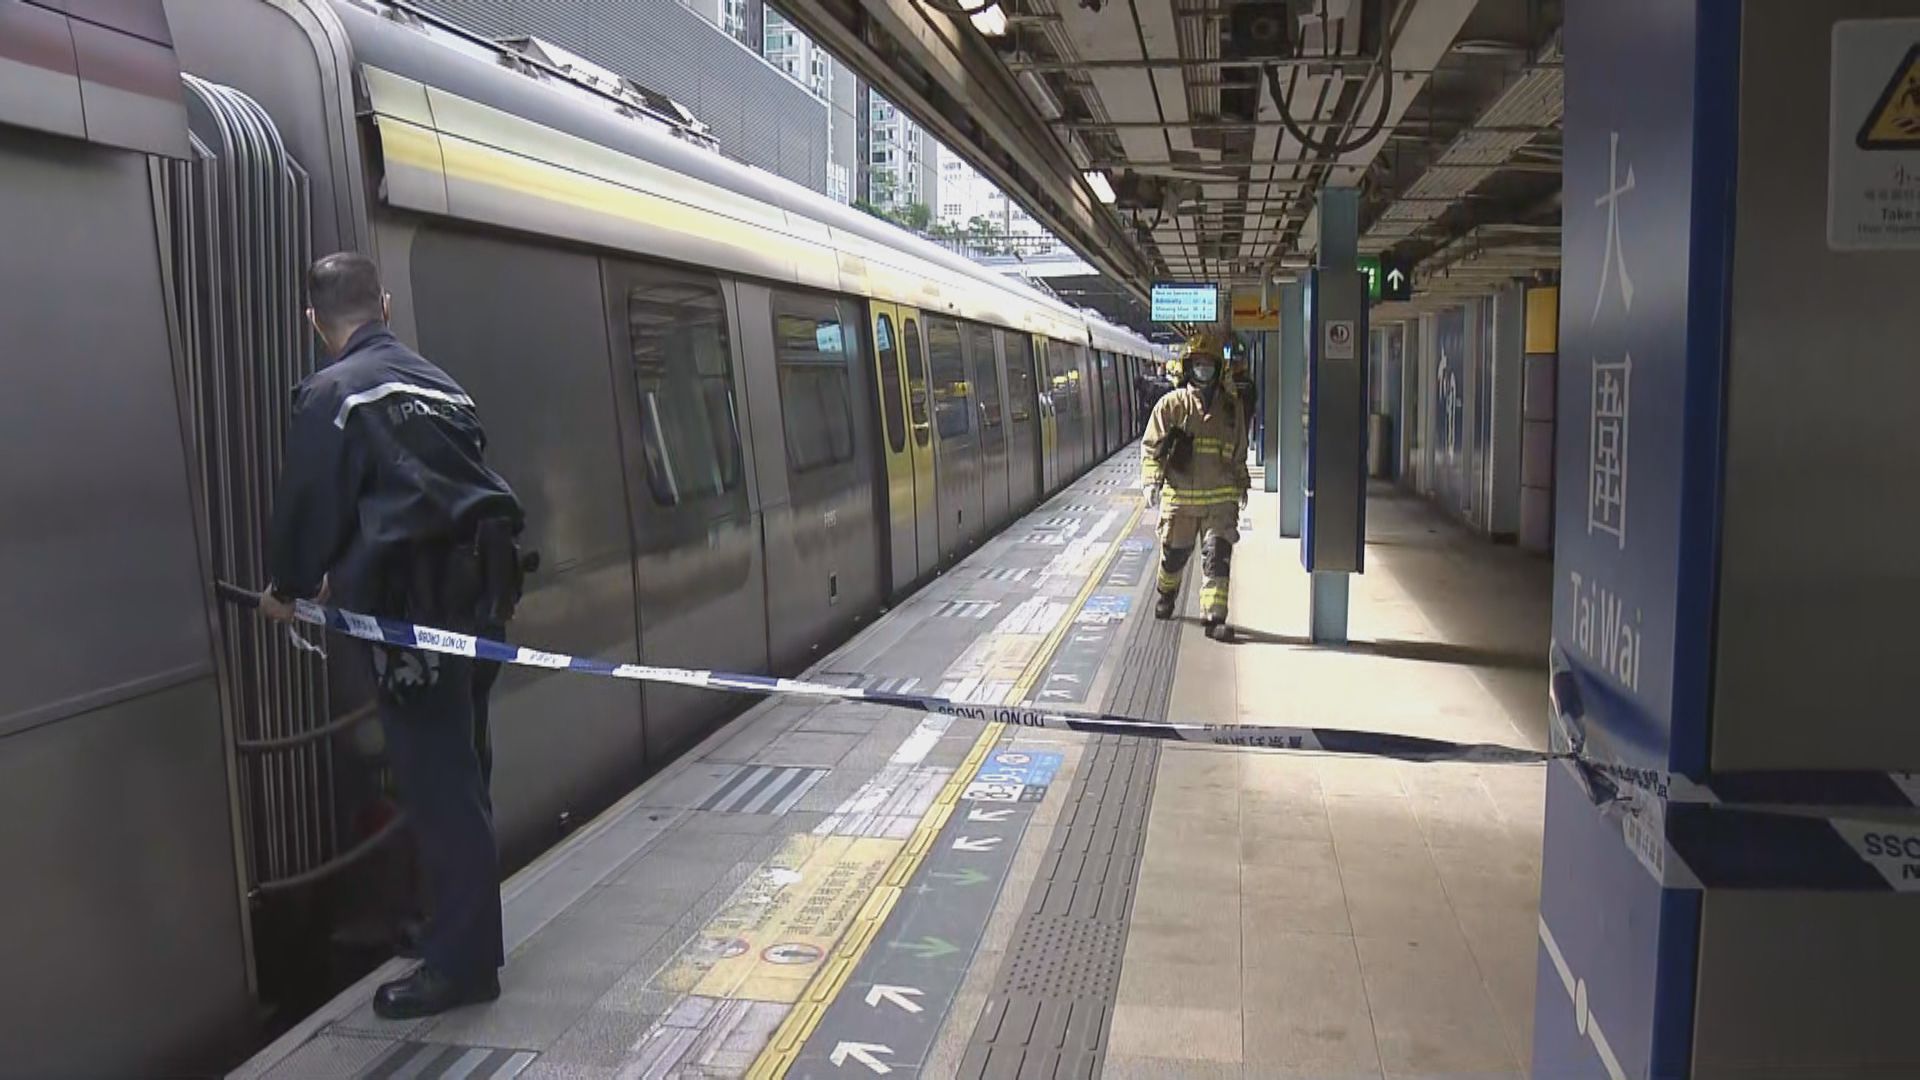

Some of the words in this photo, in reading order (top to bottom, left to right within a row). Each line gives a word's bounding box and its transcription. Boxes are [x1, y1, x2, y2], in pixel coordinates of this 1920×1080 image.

[1881, 207, 1912, 221] Take
[1588, 130, 1637, 551] 大圍
[442, 635, 456, 650] NOT
[1570, 571, 1597, 655] Tai
[1600, 589, 1643, 693] Wai
